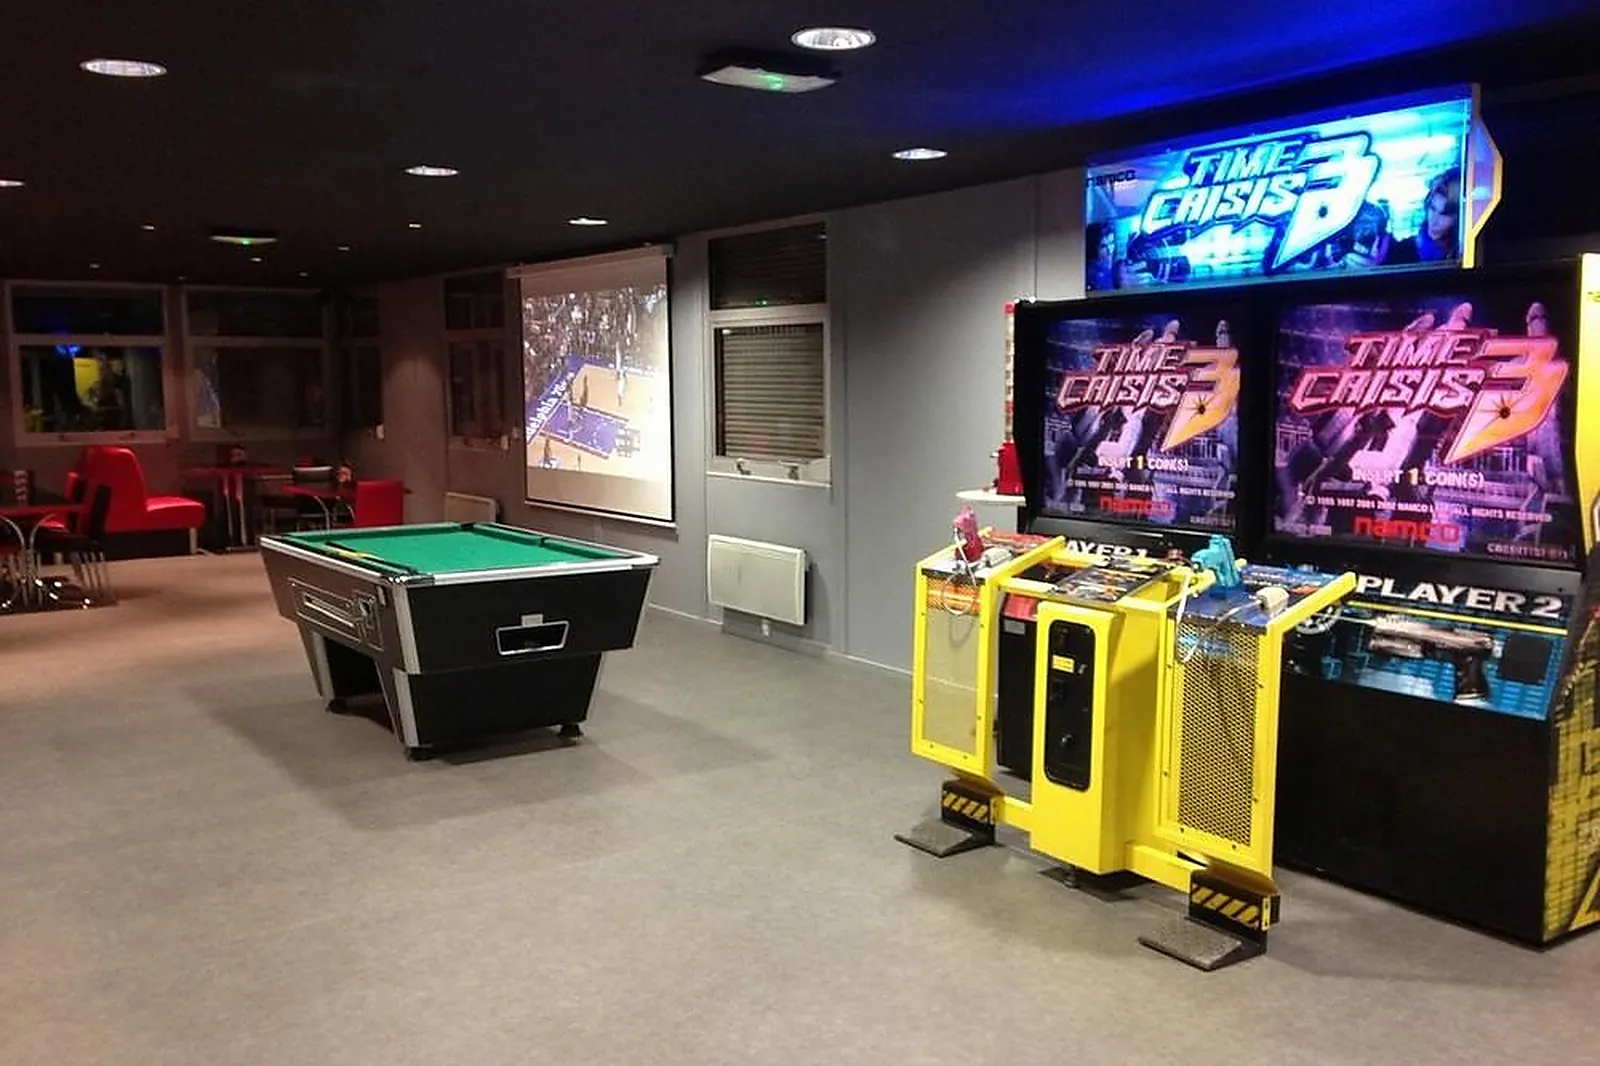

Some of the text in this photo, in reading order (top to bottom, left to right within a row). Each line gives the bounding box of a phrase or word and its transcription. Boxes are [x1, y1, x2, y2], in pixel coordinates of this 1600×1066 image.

[1186, 139, 1299, 186] TIME
[1143, 131, 1381, 270] CRISIS 3
[1094, 345, 1186, 373] TIME
[1349, 334, 1481, 368] TIME
[1057, 373, 1190, 410] CRISIS
[1160, 348, 1241, 452] 3
[1292, 336, 1569, 465] CRISIS 3
[1136, 455, 1144, 470] 1
[1408, 467, 1419, 486] 1
[1425, 471, 1485, 489] COIN(S)
[1354, 517, 1460, 541] namco
[1065, 539, 1133, 560] AYER
[1356, 573, 1563, 619] PLAYER 2
